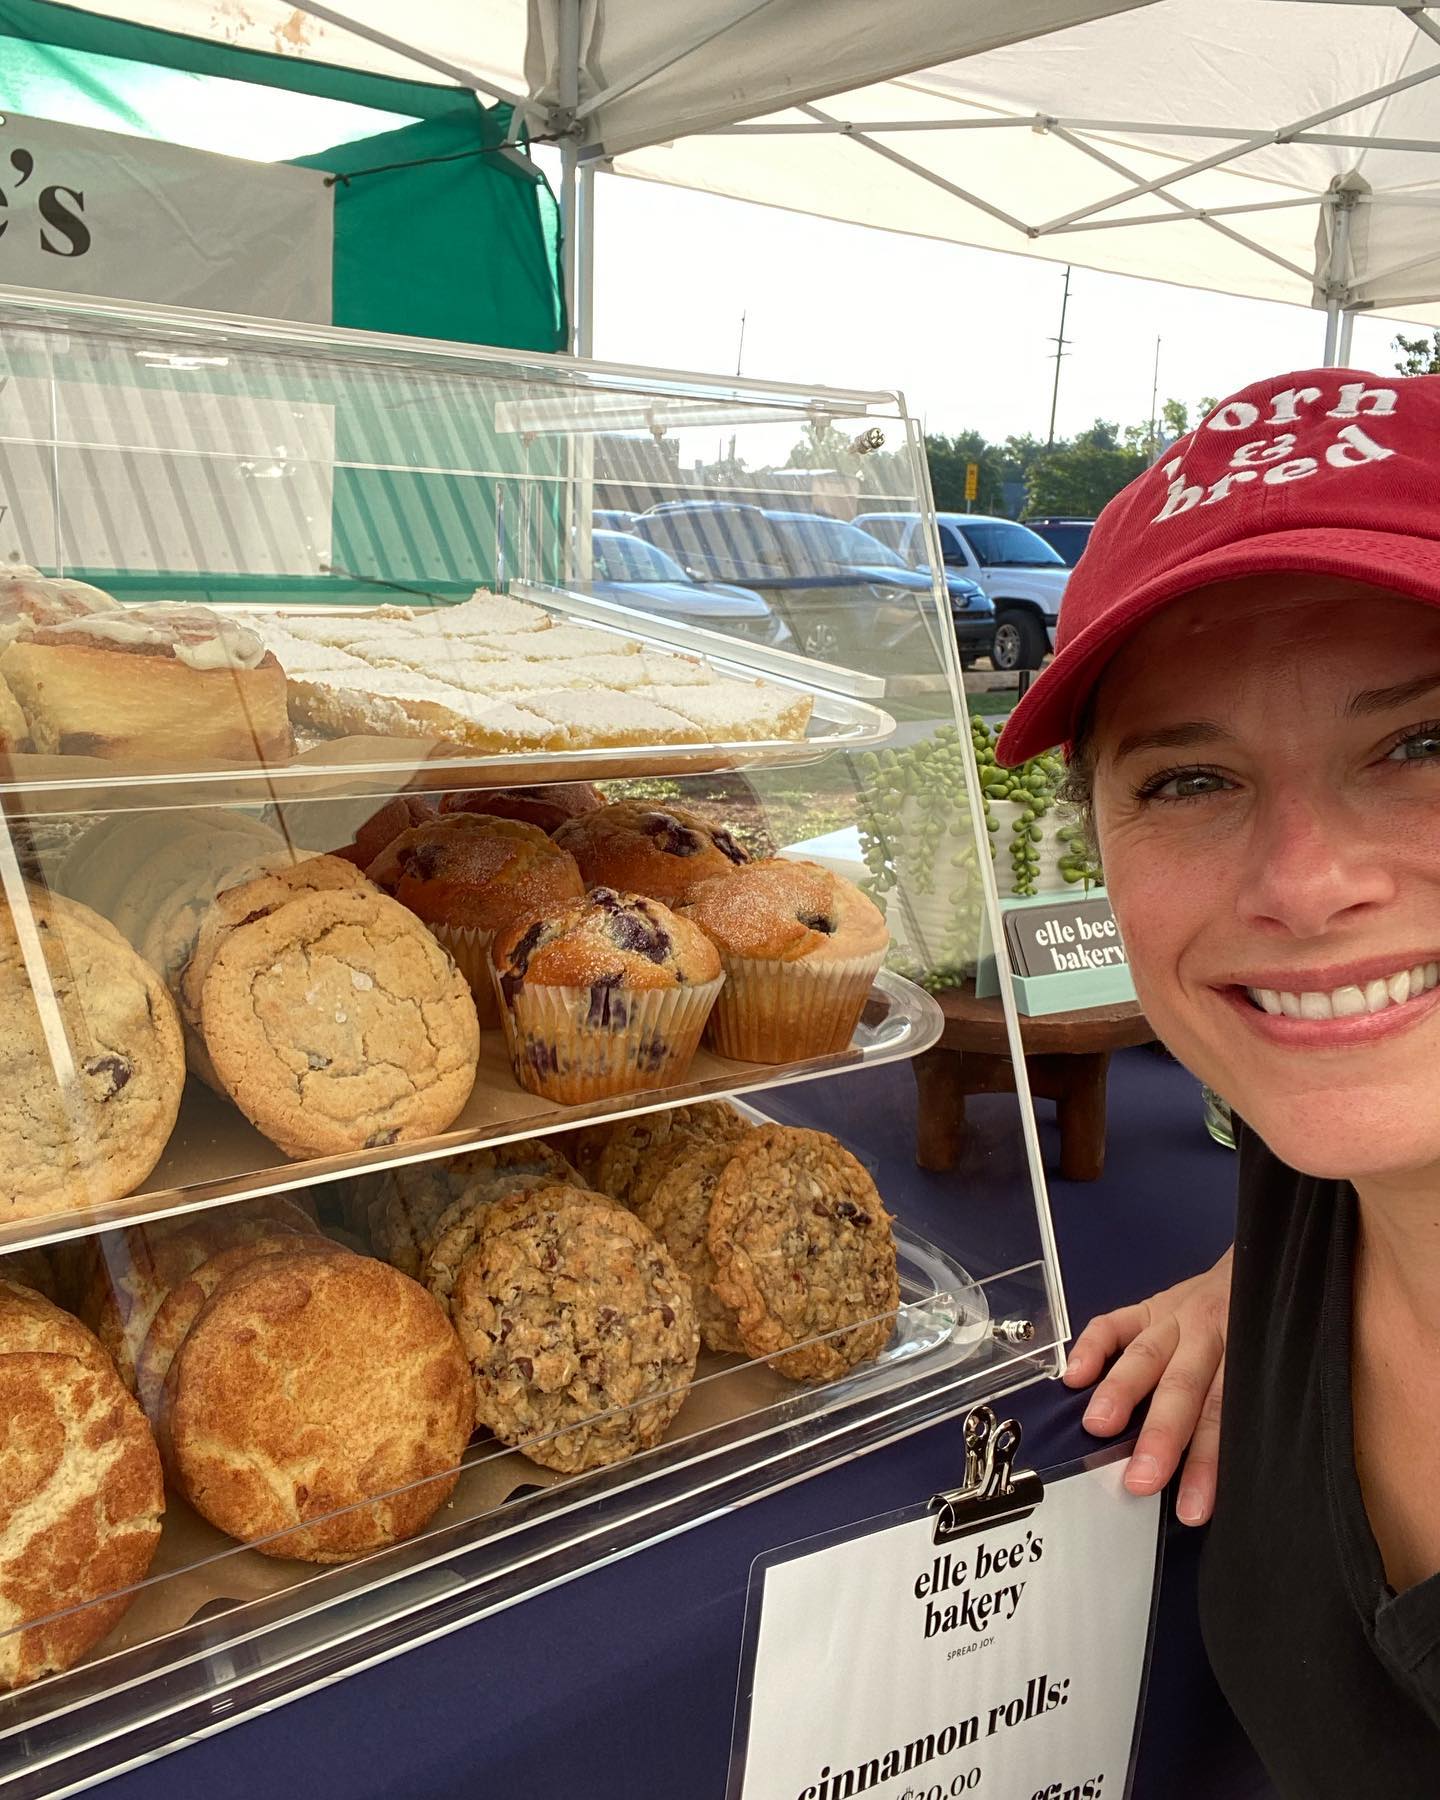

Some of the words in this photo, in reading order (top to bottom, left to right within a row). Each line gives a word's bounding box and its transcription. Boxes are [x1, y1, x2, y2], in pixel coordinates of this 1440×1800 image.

[0, 148, 91, 257] 's
[1150, 424, 1396, 523] bred
[1229, 433, 1297, 467] &
[1035, 920, 1075, 946] elle
[1075, 913, 1117, 941] bee
[913, 1553, 968, 1599] elle
[974, 1531, 1043, 1580] bee's
[924, 1580, 1027, 1638] bakery
[946, 1642, 978, 1661] SPREAD
[986, 1674, 1070, 1737] rolls:
